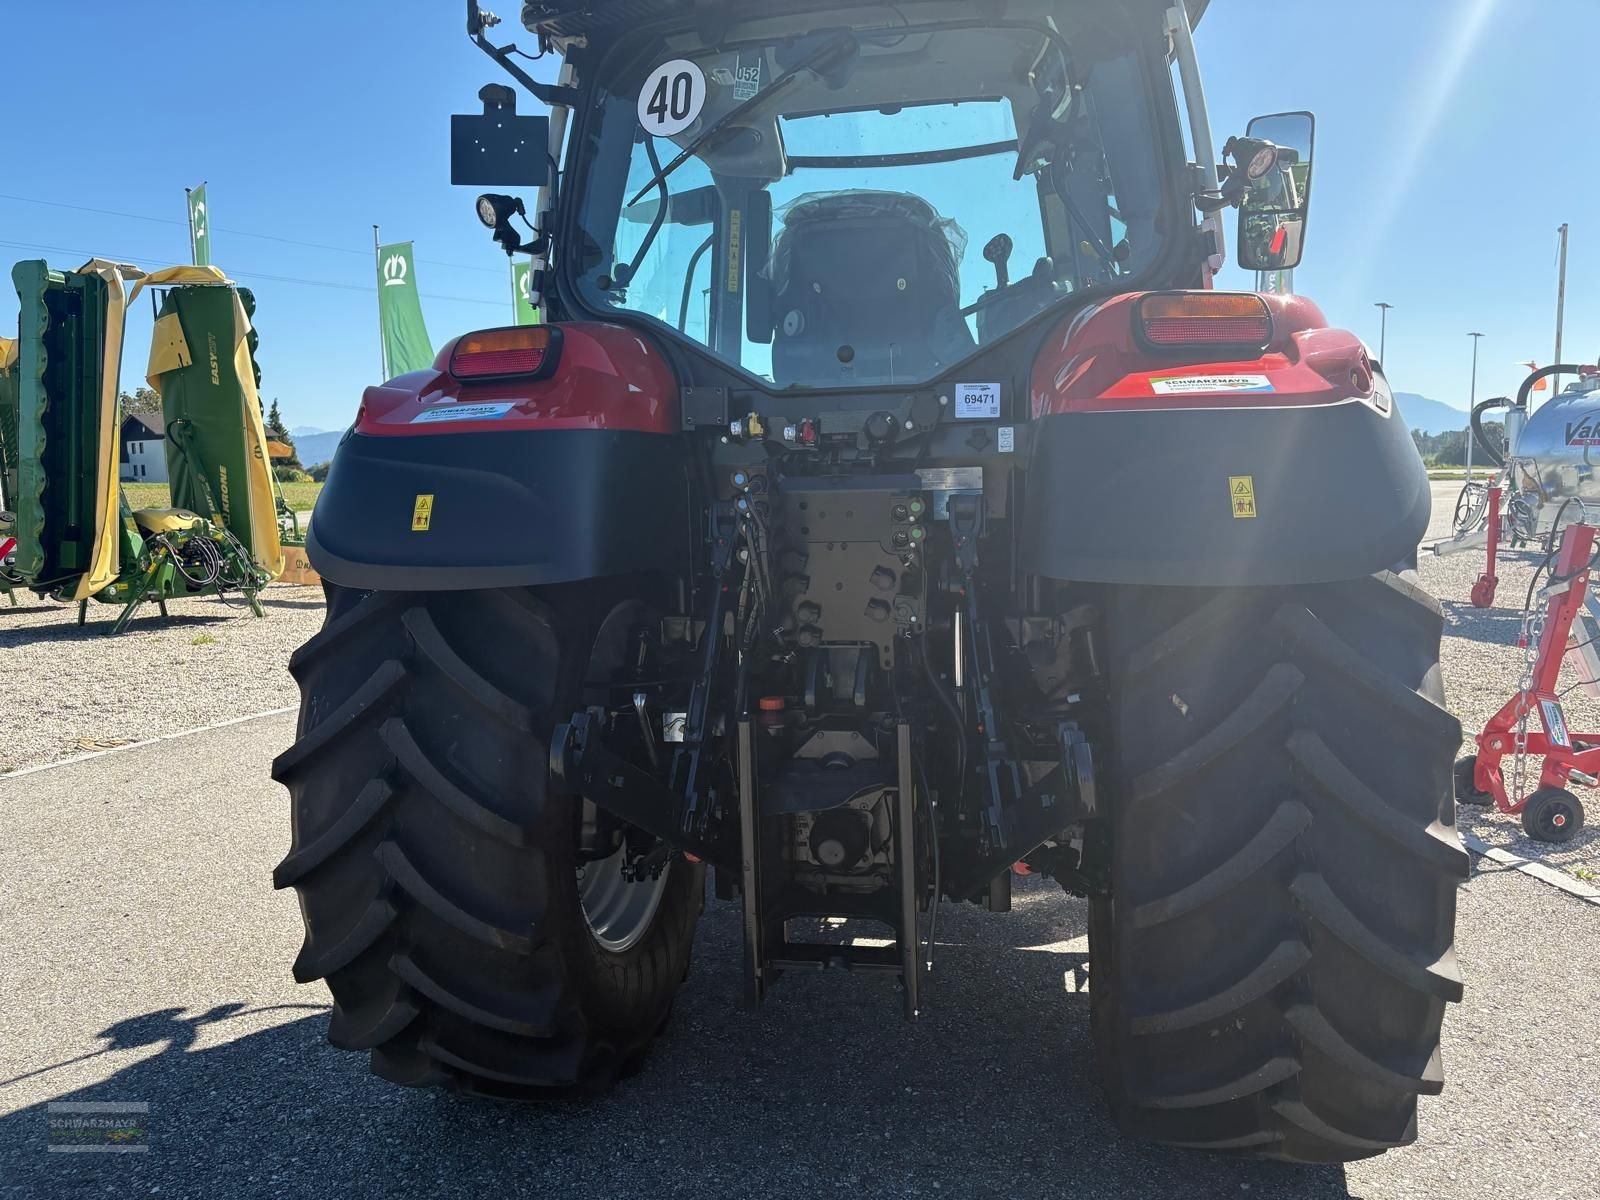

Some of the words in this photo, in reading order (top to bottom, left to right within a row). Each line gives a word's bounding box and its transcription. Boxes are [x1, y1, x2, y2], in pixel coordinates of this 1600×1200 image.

[647, 71, 693, 124] 40
[964, 394, 995, 404] 69471
[219, 464, 230, 513] KRONE
